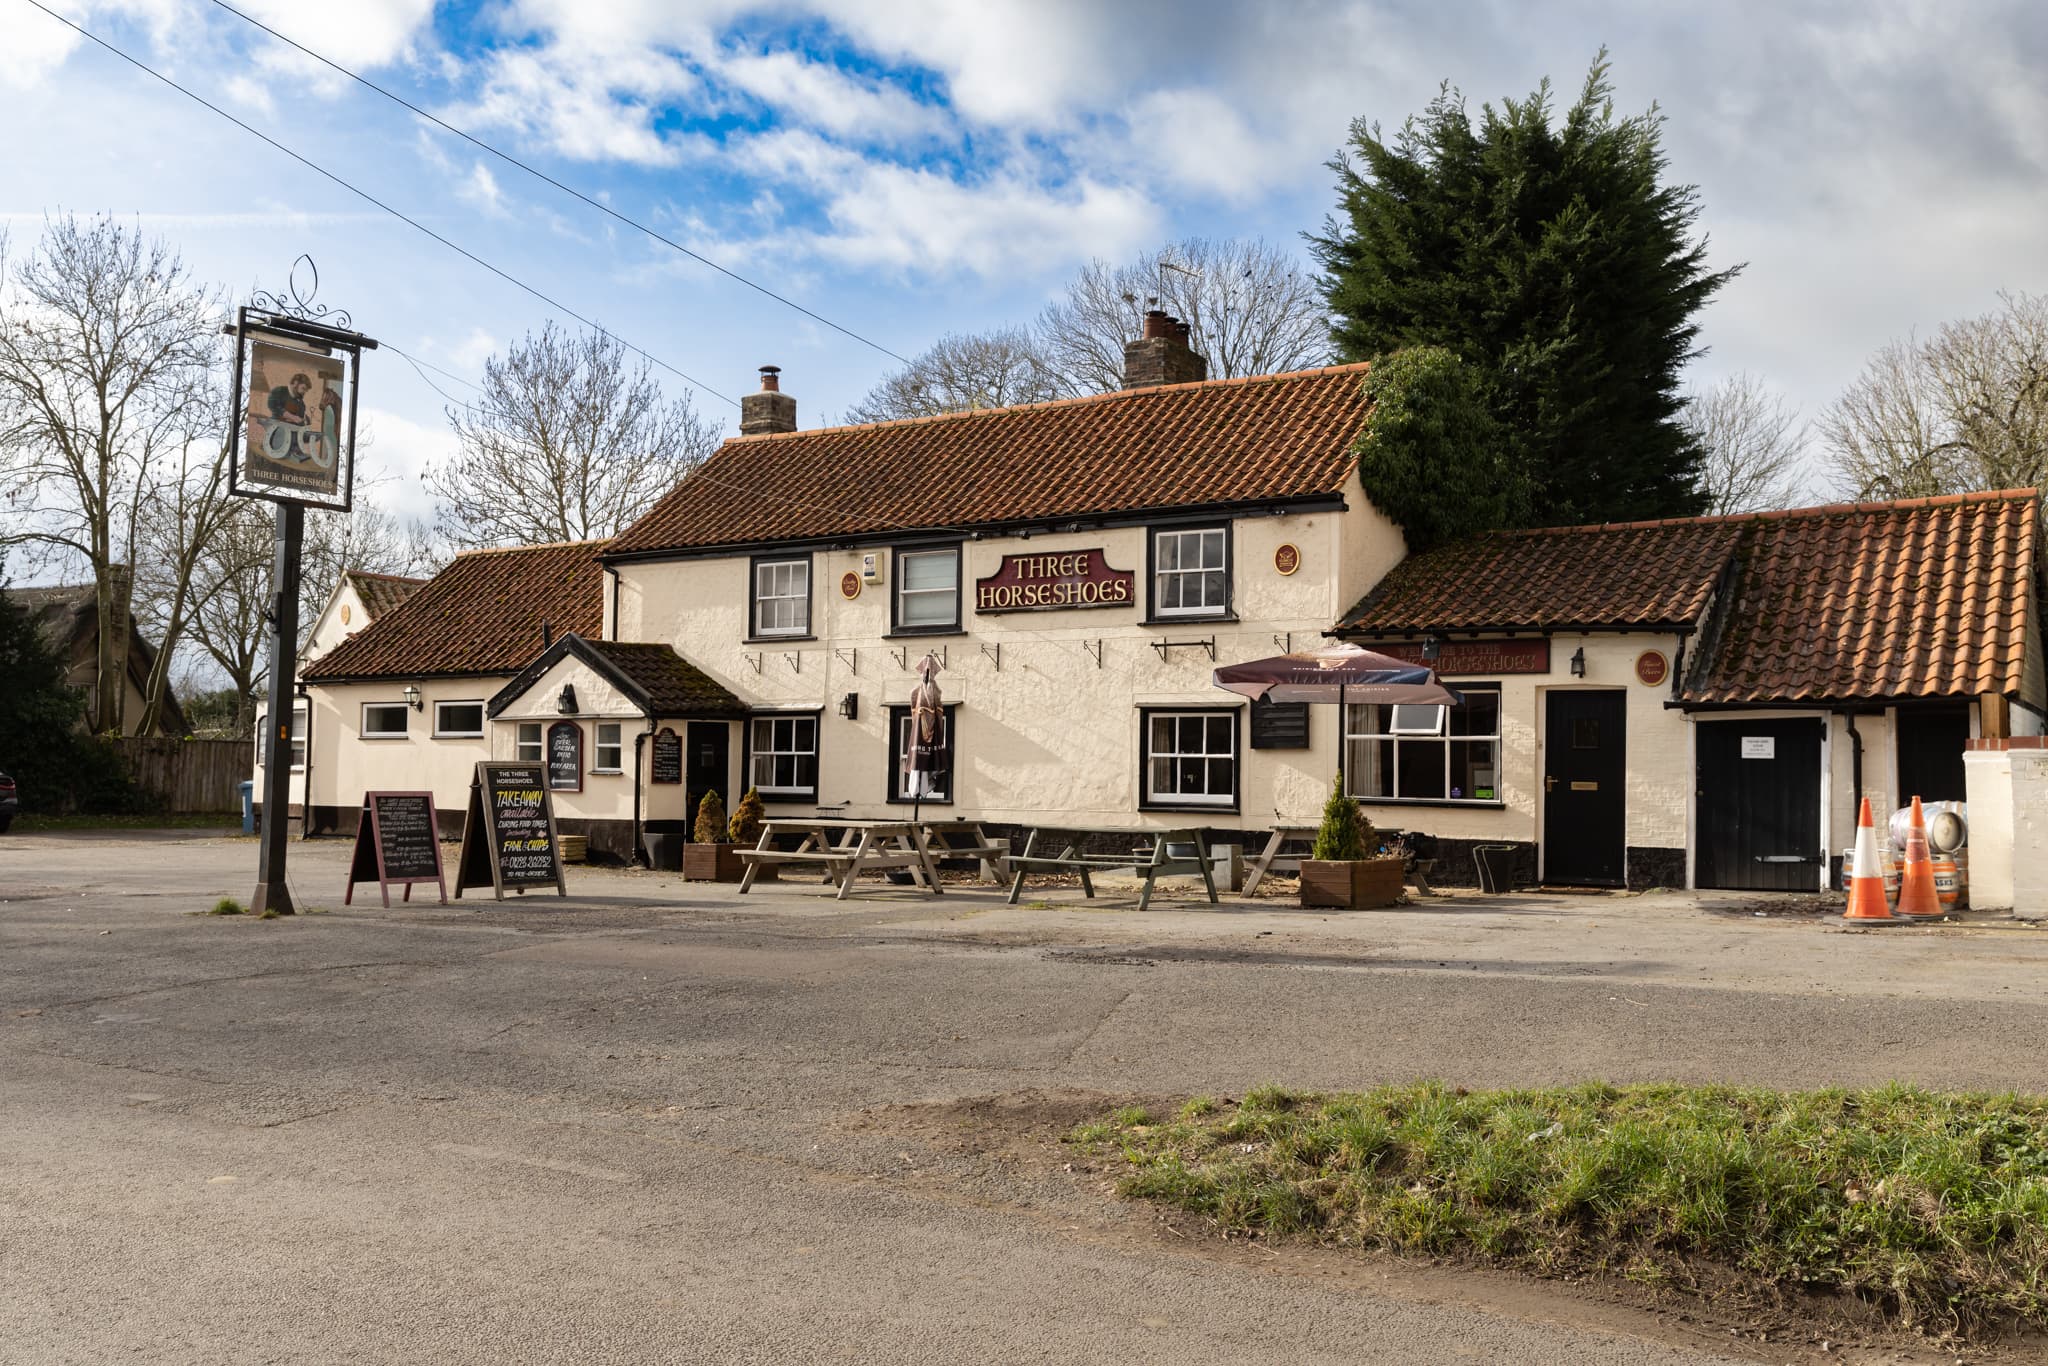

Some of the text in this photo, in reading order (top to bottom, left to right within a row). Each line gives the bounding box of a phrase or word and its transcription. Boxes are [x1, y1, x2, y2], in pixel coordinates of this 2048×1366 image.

[253, 470, 333, 489] THREE HORSESHOES
[1013, 554, 1088, 579] THREE
[979, 579, 1127, 608] HORSESHOES
[496, 790, 543, 808] TAKEAWAY
[498, 820, 519, 829] DURING
[527, 840, 549, 852] CHIPS
